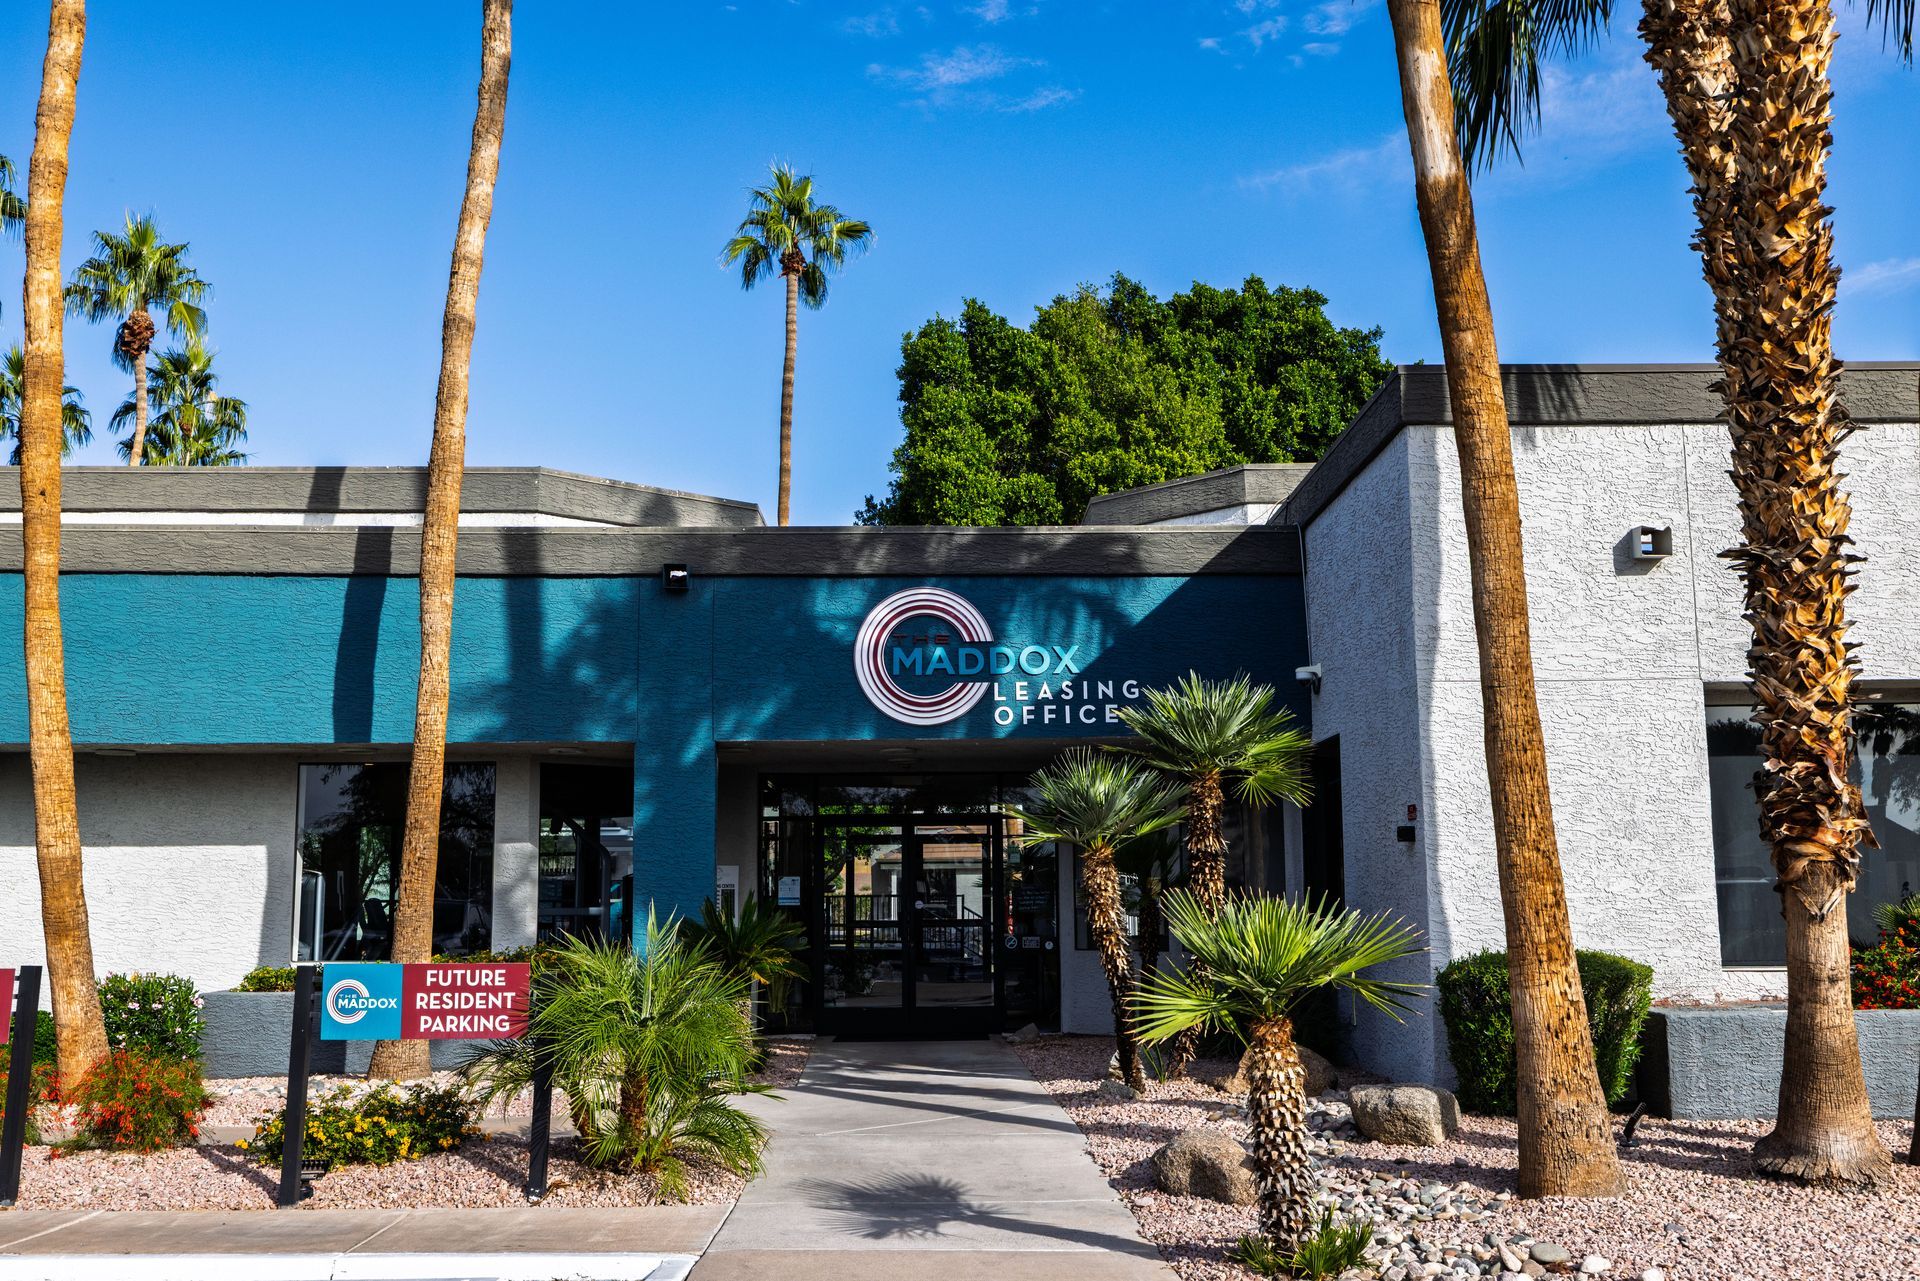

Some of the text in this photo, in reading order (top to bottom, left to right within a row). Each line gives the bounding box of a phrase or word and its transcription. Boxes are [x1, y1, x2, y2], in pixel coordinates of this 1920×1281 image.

[893, 634, 950, 645] THE
[892, 645, 1080, 675] MADDOX
[994, 679, 1140, 701] LEASING
[994, 704, 1119, 725] OFFICE
[426, 969, 506, 987] FUTURE
[337, 998, 397, 1009] MADDOX
[415, 992, 516, 1010] RESIDENT
[419, 1015, 510, 1033] PARKING
